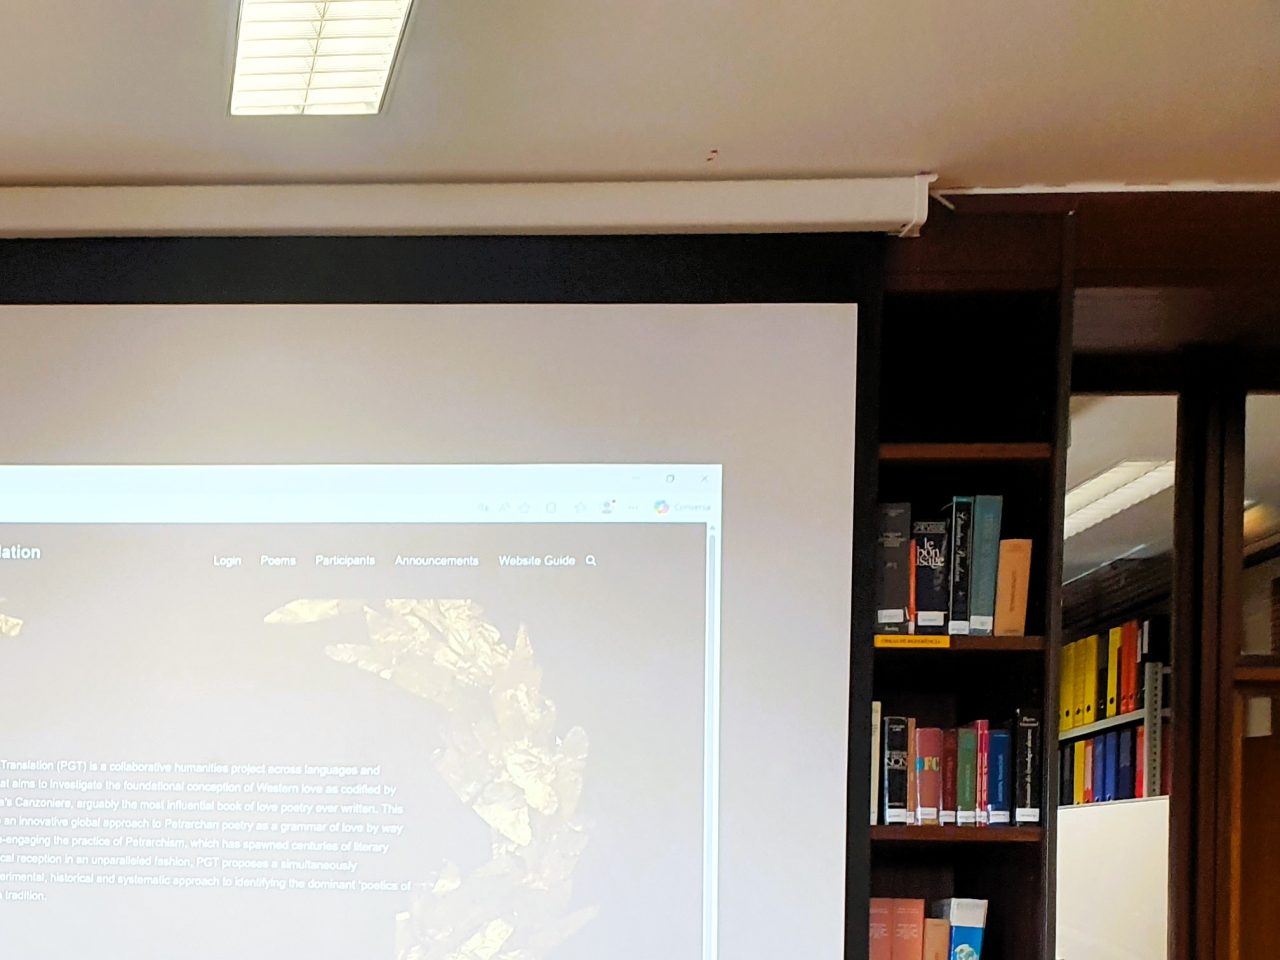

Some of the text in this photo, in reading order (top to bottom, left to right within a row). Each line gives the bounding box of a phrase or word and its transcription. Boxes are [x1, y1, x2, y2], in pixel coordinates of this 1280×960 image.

[214, 556, 241, 567] Login
[261, 556, 296, 565] Poems
[316, 555, 375, 565] Participants
[395, 557, 478, 565] Announcements
[499, 555, 575, 565] Website Guide
